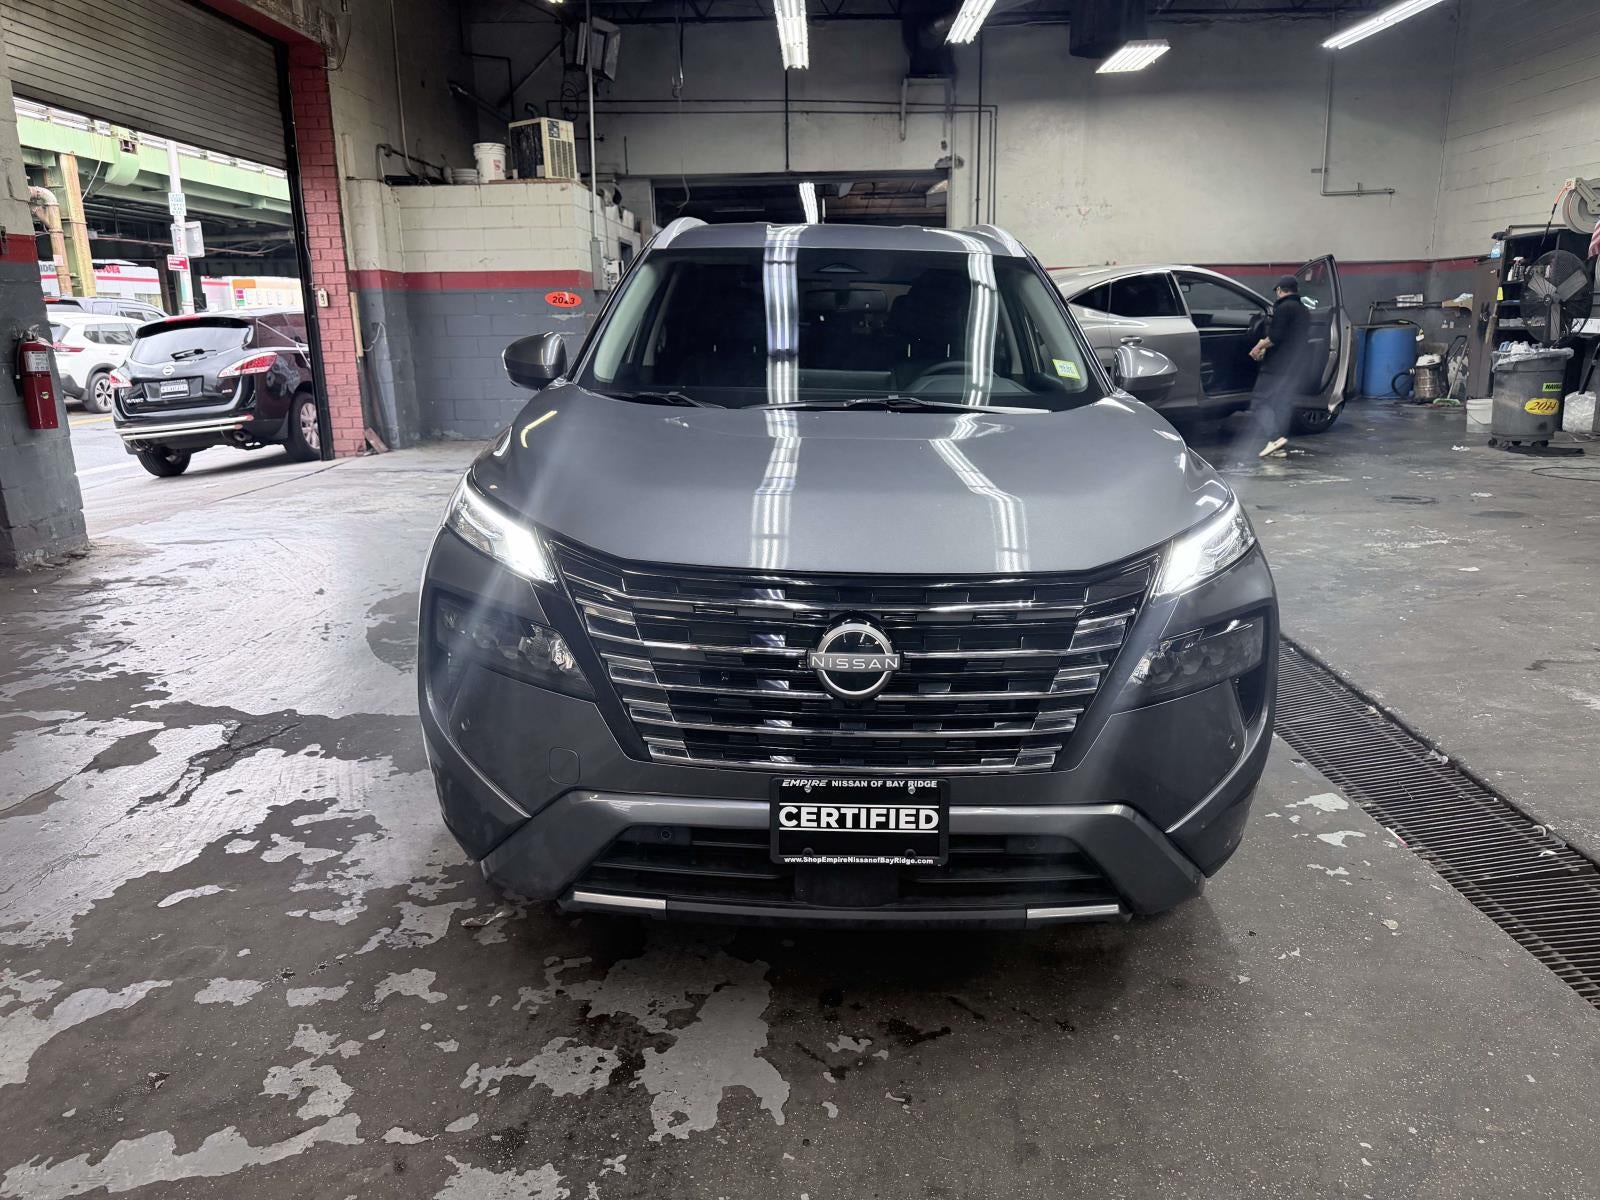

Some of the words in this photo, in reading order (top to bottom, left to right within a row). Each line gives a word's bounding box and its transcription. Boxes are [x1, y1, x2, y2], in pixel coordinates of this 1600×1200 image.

[811, 656, 898, 671] NISSAN
[782, 779, 829, 787] EMPIRE
[831, 780, 868, 788] NISSAN
[870, 780, 884, 788] OF
[885, 780, 906, 788] BAY
[907, 780, 938, 788] RIDGE
[778, 806, 940, 831] CERTIFIED
[783, 856, 934, 866] www.ShopEmpireNissanofBayRidge.com
